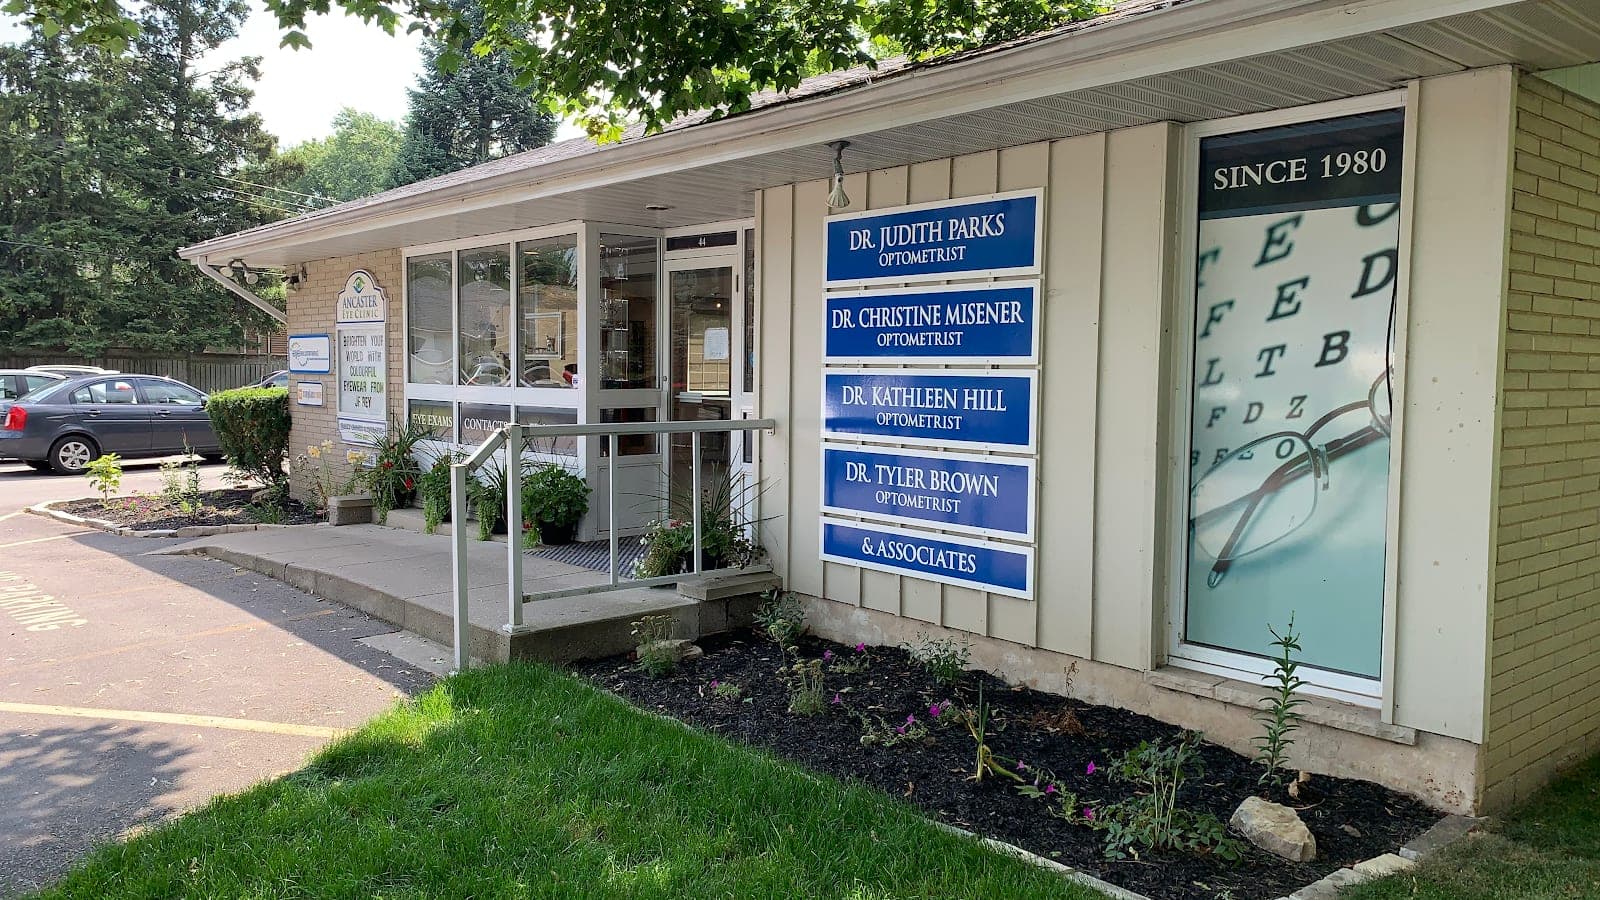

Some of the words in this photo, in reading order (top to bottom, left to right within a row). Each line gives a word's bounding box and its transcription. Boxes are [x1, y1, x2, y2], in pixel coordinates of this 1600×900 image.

[1213, 158, 1308, 190] SINCE
[1320, 148, 1387, 178] 1980
[849, 229, 875, 250] DR.
[879, 220, 943, 254] JUDITH
[948, 212, 1005, 240] PARKS
[1253, 214, 1304, 268] E
[879, 246, 966, 267] OPTOMETRIST
[1266, 275, 1310, 322] E
[1351, 248, 1398, 299] D
[343, 295, 378, 308] ANCASTER
[354, 309, 379, 318] CLINIC
[831, 309, 855, 329] DR.
[858, 305, 941, 328] CHRISTINE
[945, 301, 1024, 325] MISENER
[343, 335, 367, 347] BRIGHTEN
[877, 332, 963, 347] OPTOMETRIST
[346, 350, 364, 362] WORLD
[1199, 358, 1224, 388] L
[1255, 344, 1287, 378] T
[1314, 330, 1351, 368] B
[343, 380, 367, 392] EYEWEAR
[370, 381, 384, 394] FROM
[842, 385, 867, 405] DR.
[872, 386, 957, 409] KATHLEEN
[963, 388, 1007, 412] HILL
[412, 413, 427, 426] EYE
[428, 415, 453, 428] EXAMS
[876, 412, 962, 430] OPTOMETRIST
[1206, 406, 1227, 428] F
[1243, 402, 1264, 424] D
[1286, 395, 1308, 419] Z
[845, 462, 870, 483] DR.
[874, 464, 927, 490] TYLER
[929, 470, 999, 498] BROWN
[875, 491, 961, 514] OPTOMETRIST
[861, 537, 875, 556] &
[876, 541, 976, 574] ASSOCIATES
